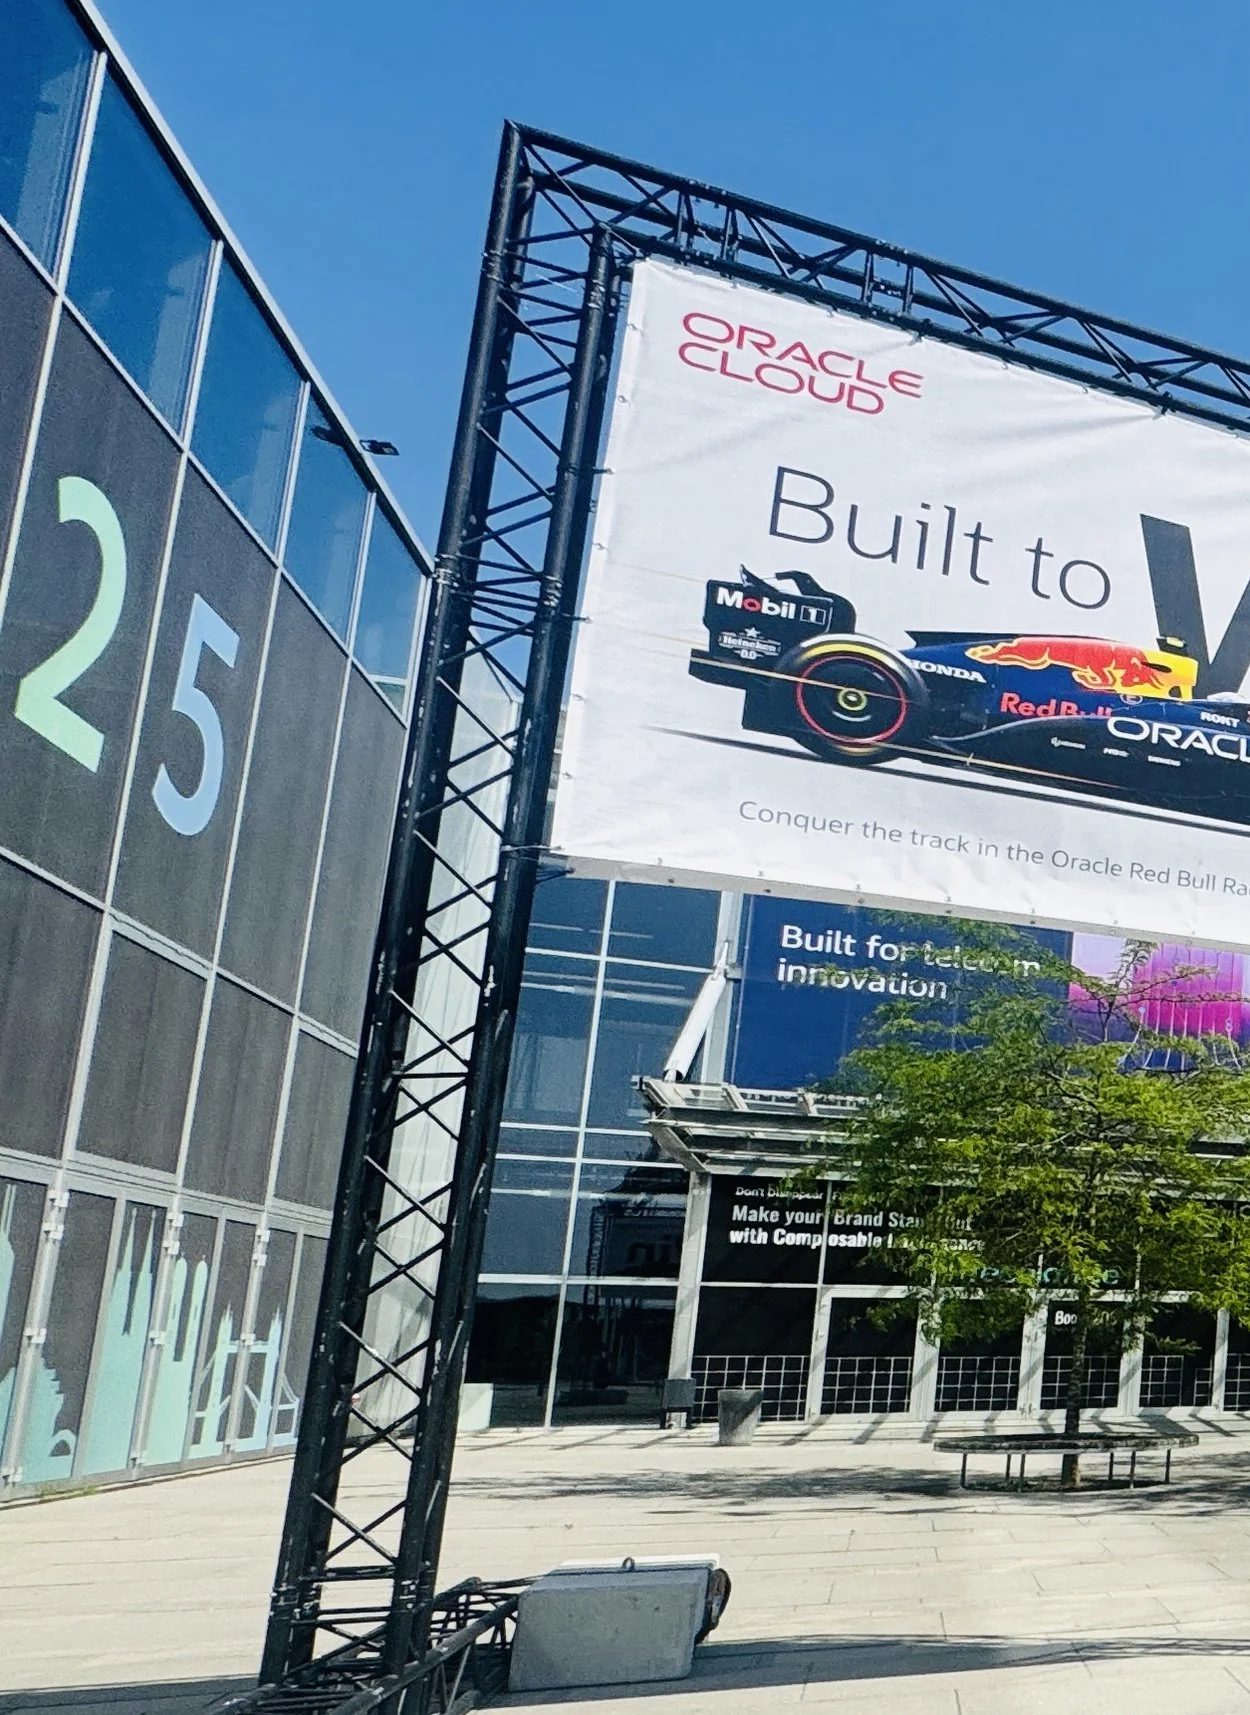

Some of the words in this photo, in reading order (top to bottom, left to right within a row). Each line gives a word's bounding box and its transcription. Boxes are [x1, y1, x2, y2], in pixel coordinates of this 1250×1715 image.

[682, 312, 924, 399] ORACLE
[679, 344, 884, 415] CLOUD
[769, 466, 993, 586] Built
[1025, 536, 1111, 610] to
[716, 586, 796, 619] Mobil
[721, 634, 778, 653] Heineken
[1000, 692, 1056, 717] Red
[1060, 702, 1112, 718] Bll
[739, 801, 854, 833] Conquer
[861, 821, 902, 842] the
[909, 829, 970, 853] track
[977, 838, 999, 858] in
[1007, 844, 1044, 865] the
[1051, 850, 1122, 877] Oracle
[1130, 862, 1170, 884] Red
[1177, 870, 1216, 892] Bull
[780, 924, 857, 956] Built
[866, 934, 911, 961] for
[923, 942, 1041, 977] telem
[777, 958, 948, 999] innovation
[732, 1205, 779, 1223] Make
[785, 1210, 822, 1227] your
[833, 1211, 883, 1227] Brand
[888, 1212, 925, 1229] Stan
[730, 1228, 768, 1245] with
[1055, 1309, 1078, 1326] Boo
